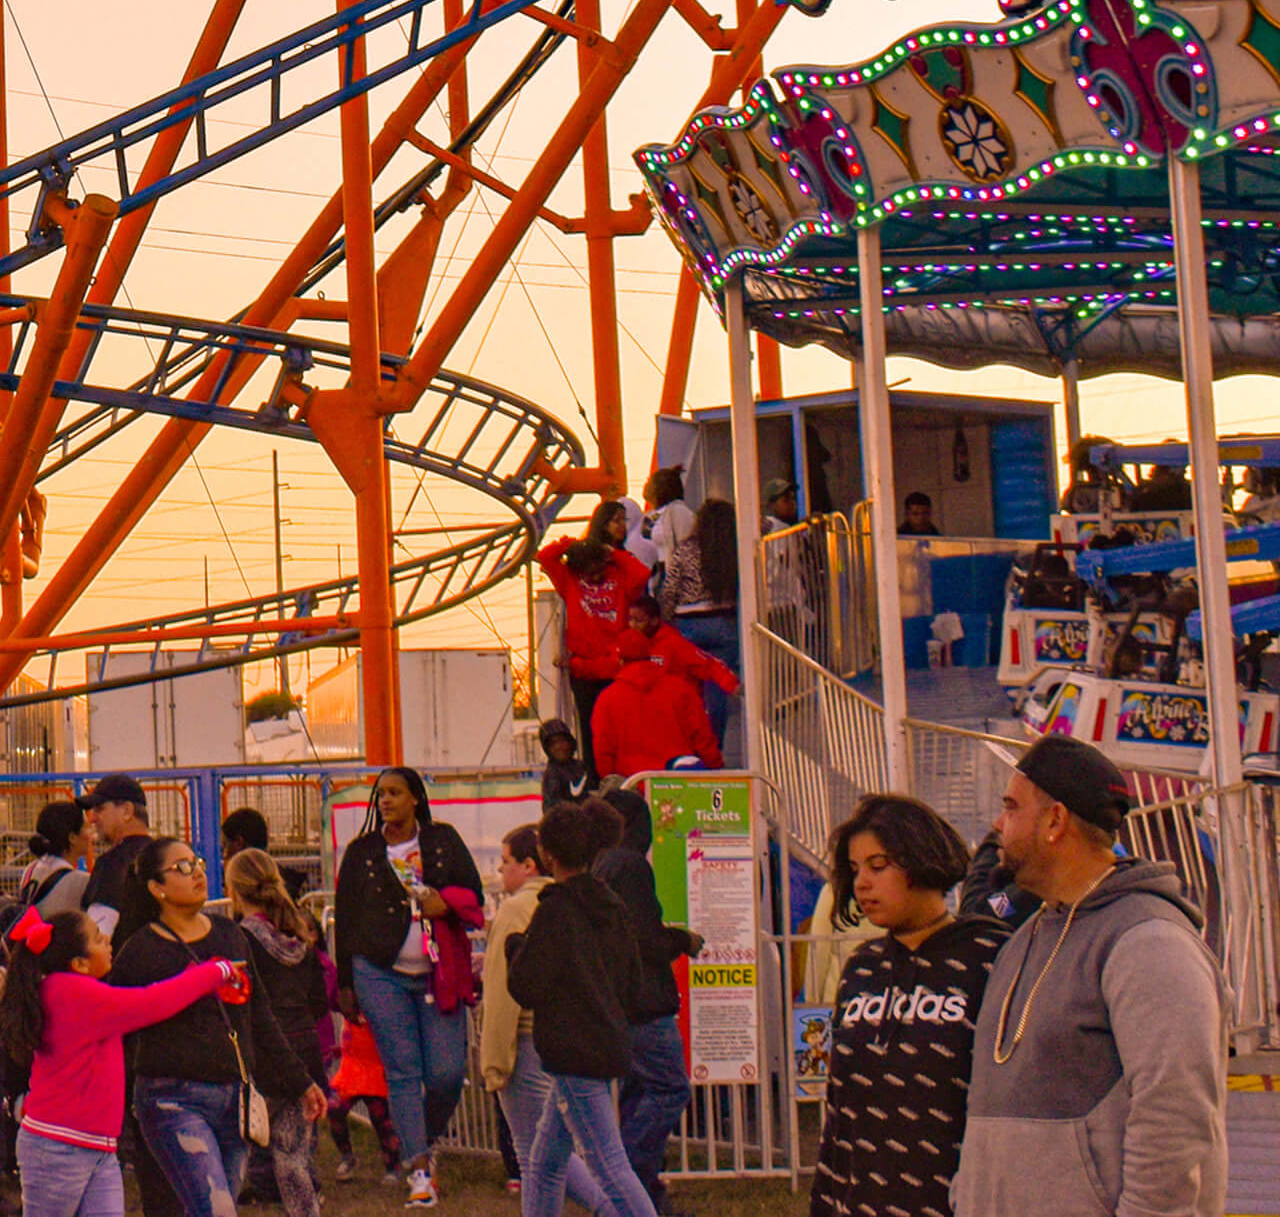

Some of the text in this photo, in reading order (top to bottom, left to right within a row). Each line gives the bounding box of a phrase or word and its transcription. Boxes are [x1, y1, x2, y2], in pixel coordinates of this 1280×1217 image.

[713, 789, 722, 809] 6
[696, 810, 741, 821] Tickets
[693, 969, 752, 984] NOTICE
[843, 985, 967, 1022] adidas
